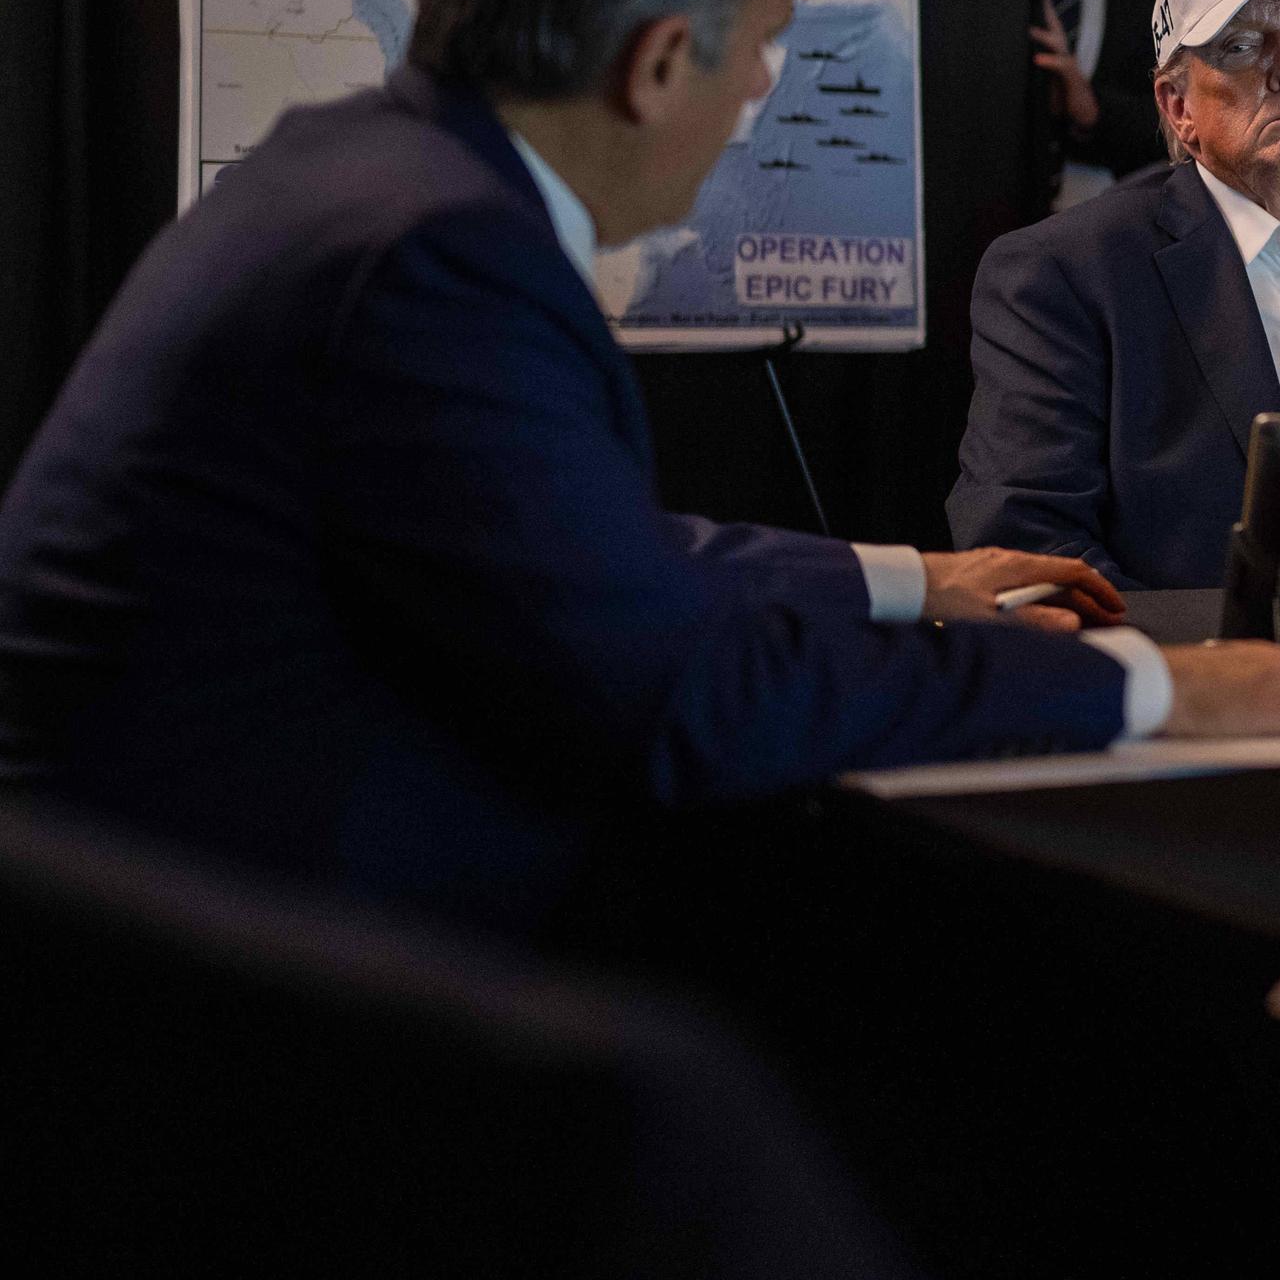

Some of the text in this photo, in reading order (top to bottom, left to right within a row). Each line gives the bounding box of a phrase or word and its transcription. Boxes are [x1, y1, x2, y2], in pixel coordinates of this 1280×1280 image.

[234, 144, 257, 154] Sud
[737, 235, 905, 265] OPERATION
[745, 274, 898, 303] EPIC FURY
